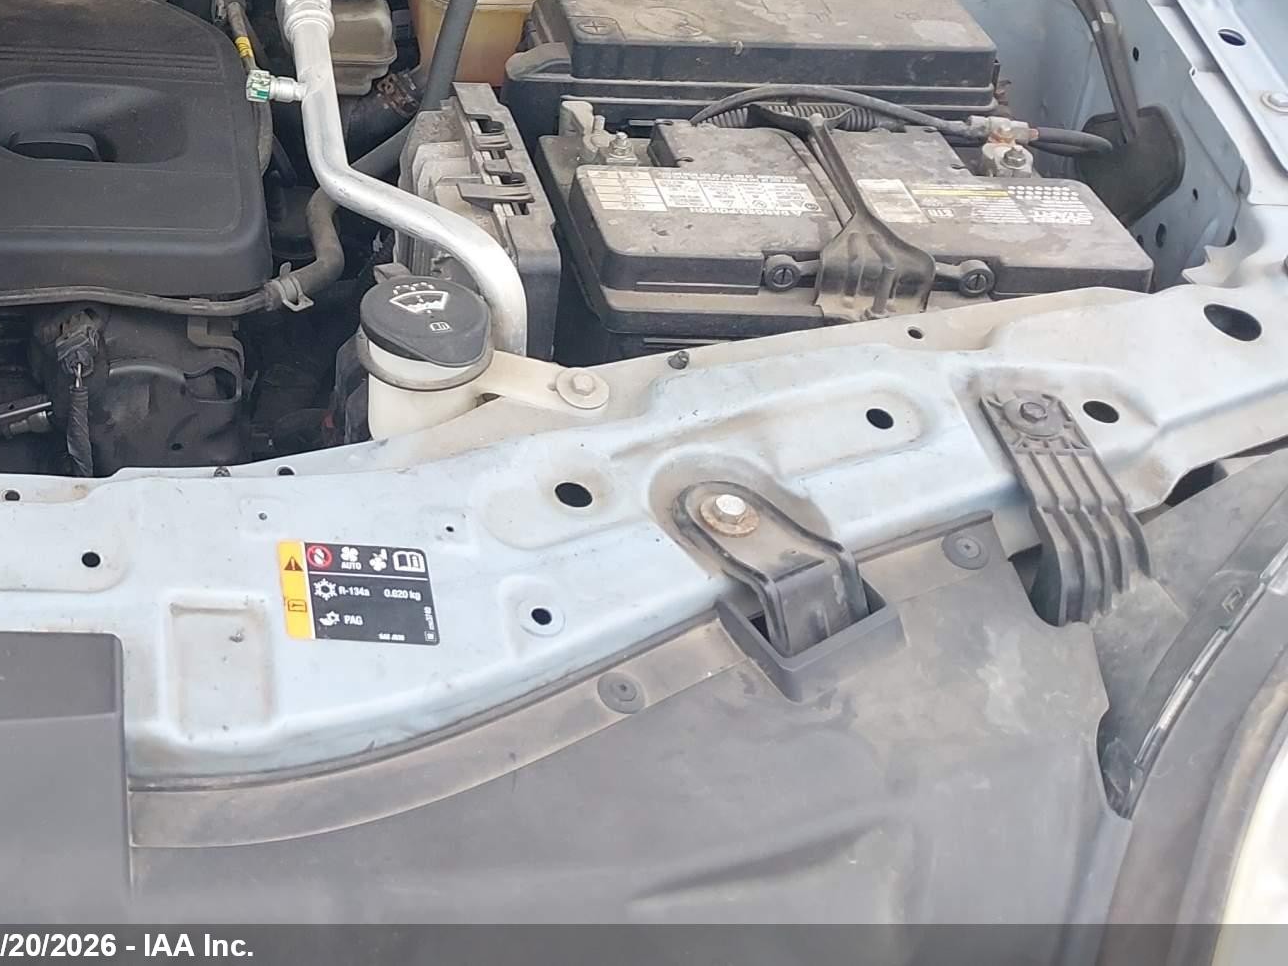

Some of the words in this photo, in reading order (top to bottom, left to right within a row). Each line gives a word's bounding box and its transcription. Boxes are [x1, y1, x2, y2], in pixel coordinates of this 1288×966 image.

[341, 561, 362, 570] AUTO
[338, 585, 370, 597] R-134a
[409, 590, 422, 601] kg
[343, 615, 364, 626] PAG
